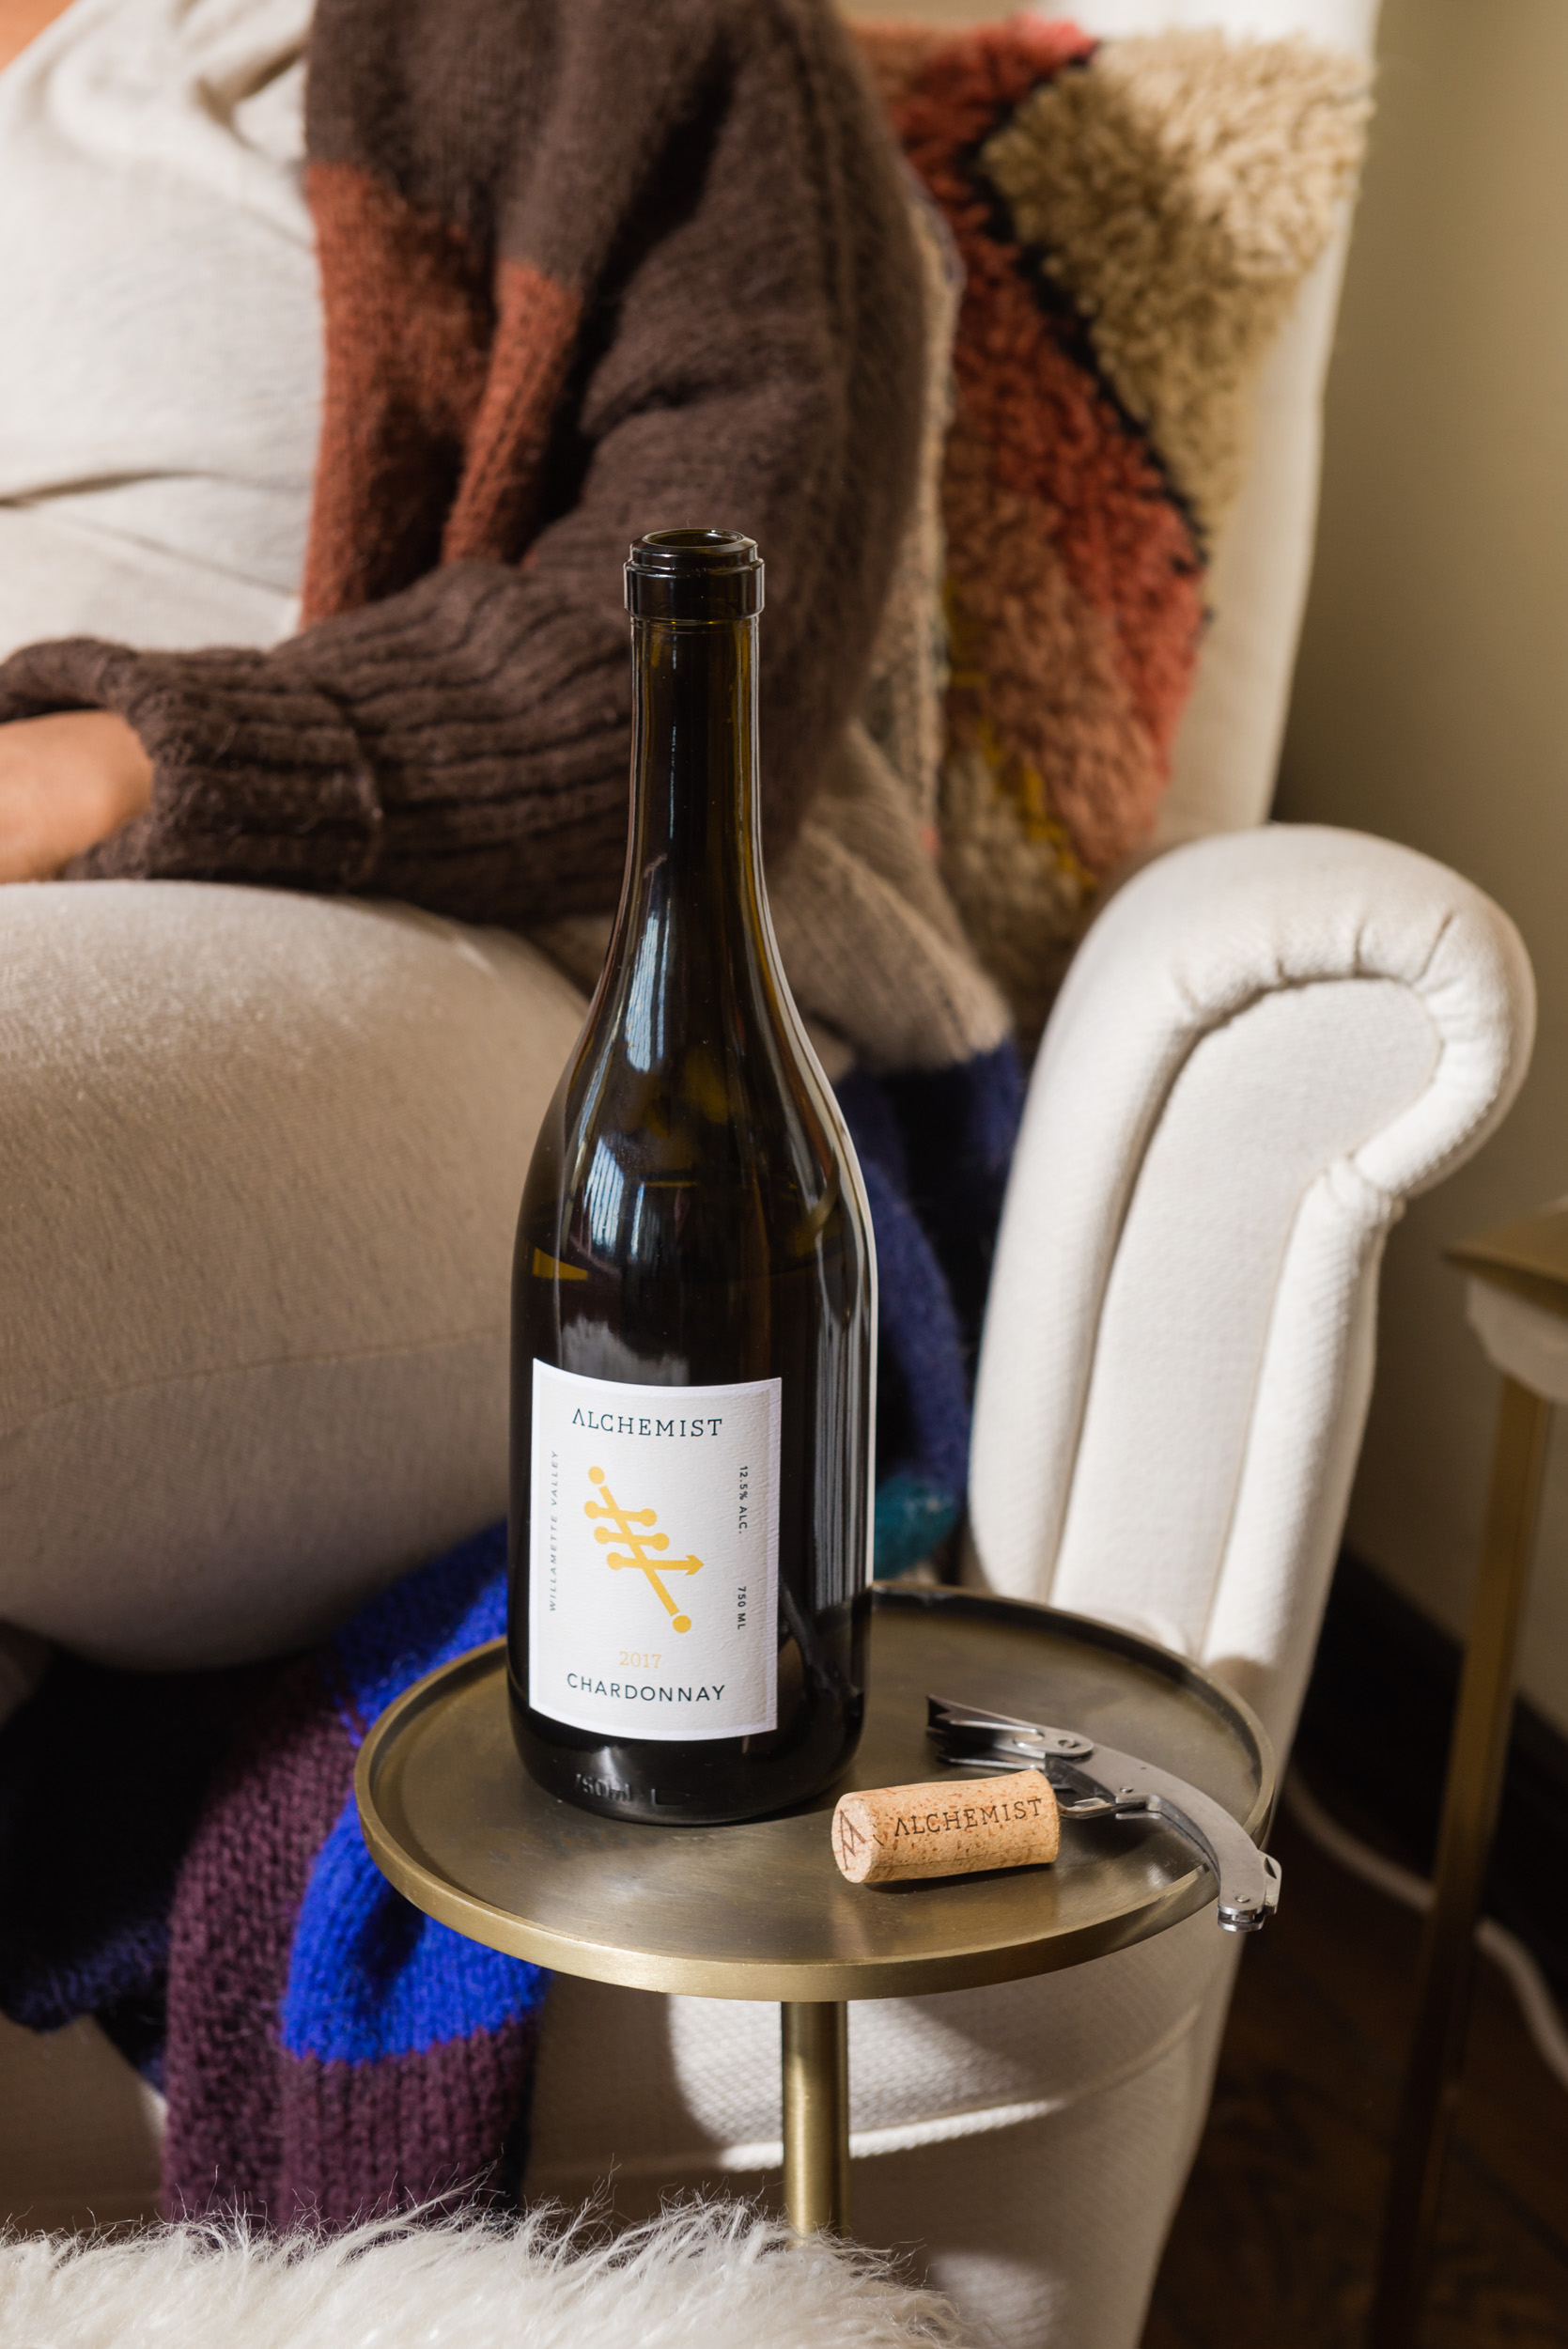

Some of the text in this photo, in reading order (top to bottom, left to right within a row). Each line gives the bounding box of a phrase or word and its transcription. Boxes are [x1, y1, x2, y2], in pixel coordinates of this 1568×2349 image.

[571, 1408, 723, 1438] ALCHEMIST
[738, 1465, 749, 1534] 12.5% ALC.
[549, 1450, 559, 1612] WILLAMETTE VALLEY
[737, 1585, 747, 1630] 750 ML
[618, 1650, 662, 1669] 2017
[566, 1672, 726, 1703] CHARDONNAY
[893, 1797, 1044, 1838] ALCHEMIST
